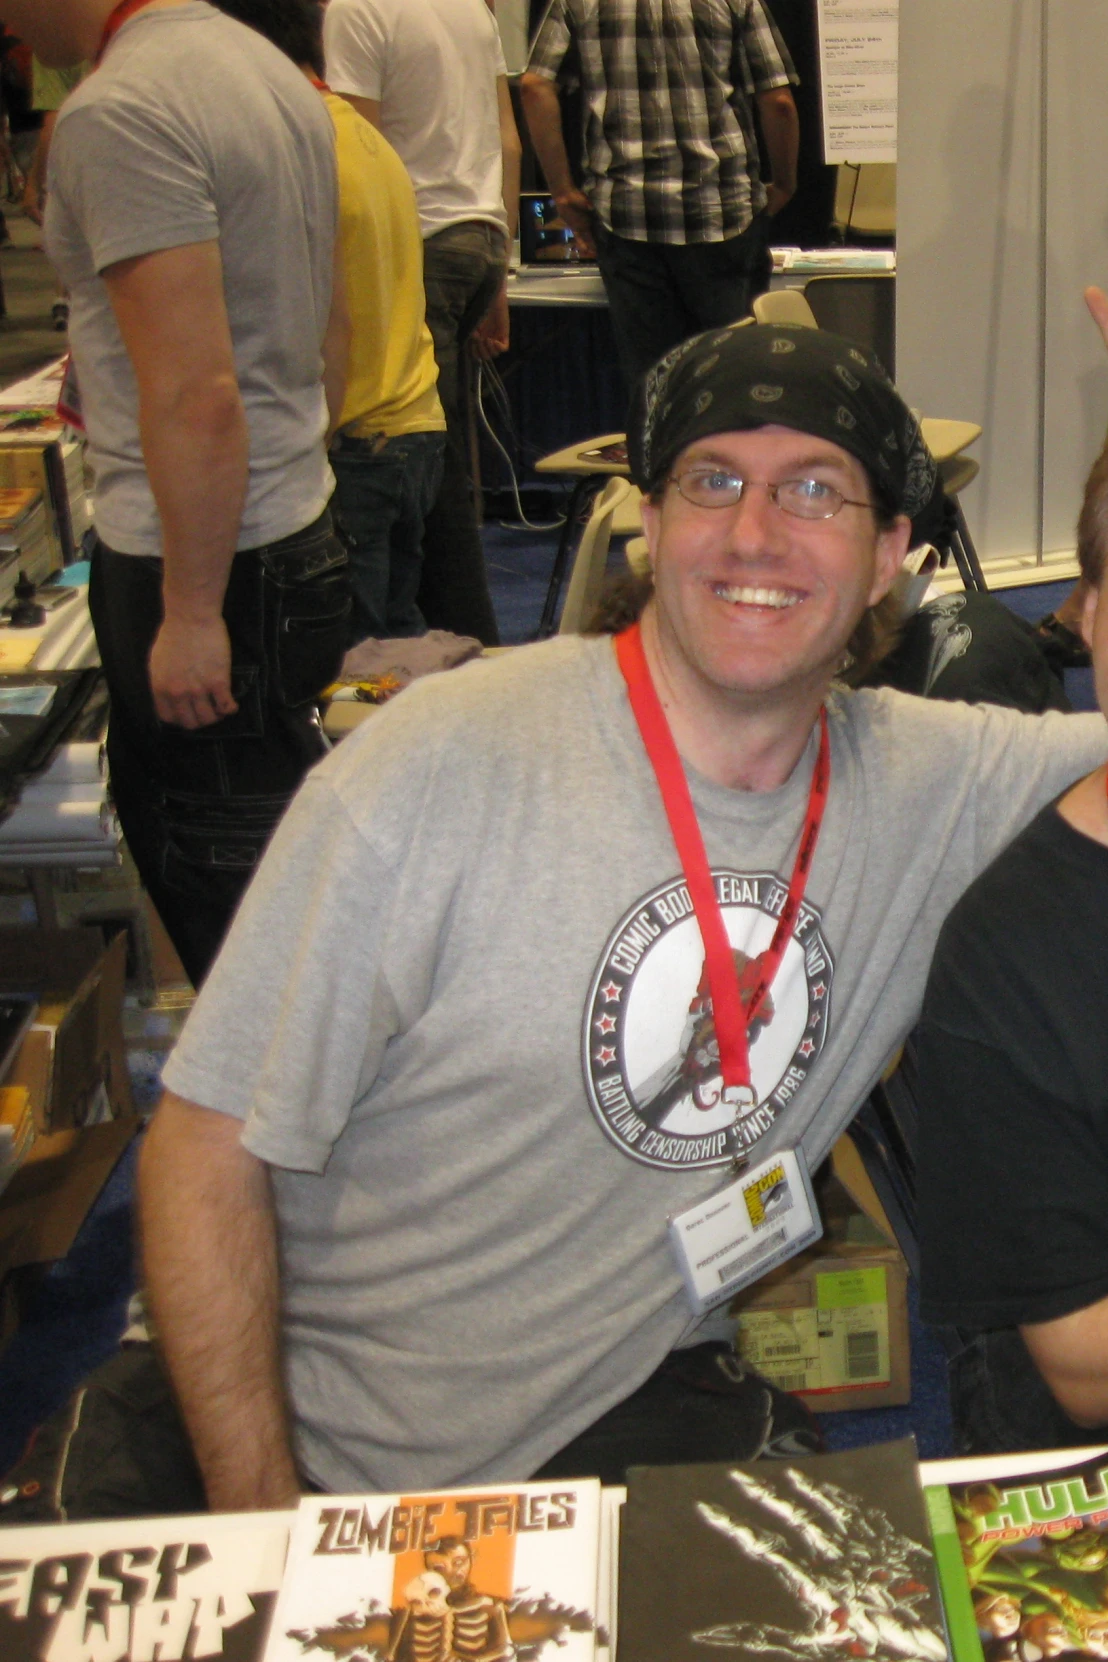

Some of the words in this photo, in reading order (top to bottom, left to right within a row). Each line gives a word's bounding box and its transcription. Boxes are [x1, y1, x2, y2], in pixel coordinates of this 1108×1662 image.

[611, 911, 661, 975] COMIC
[654, 886, 694, 925] BOO
[717, 877, 761, 904] EGAL
[598, 1073, 647, 1144] BATTLING
[640, 1130, 727, 1162] CENSORSHIP
[774, 1065, 807, 1108] 1986
[758, 1165, 786, 1193] CON
[695, 1234, 749, 1270] PROFESSIONAL
[313, 1502, 445, 1556] ZOMBIE
[455, 1491, 578, 1542] TALES
[980, 1517, 1084, 1543] POWER
